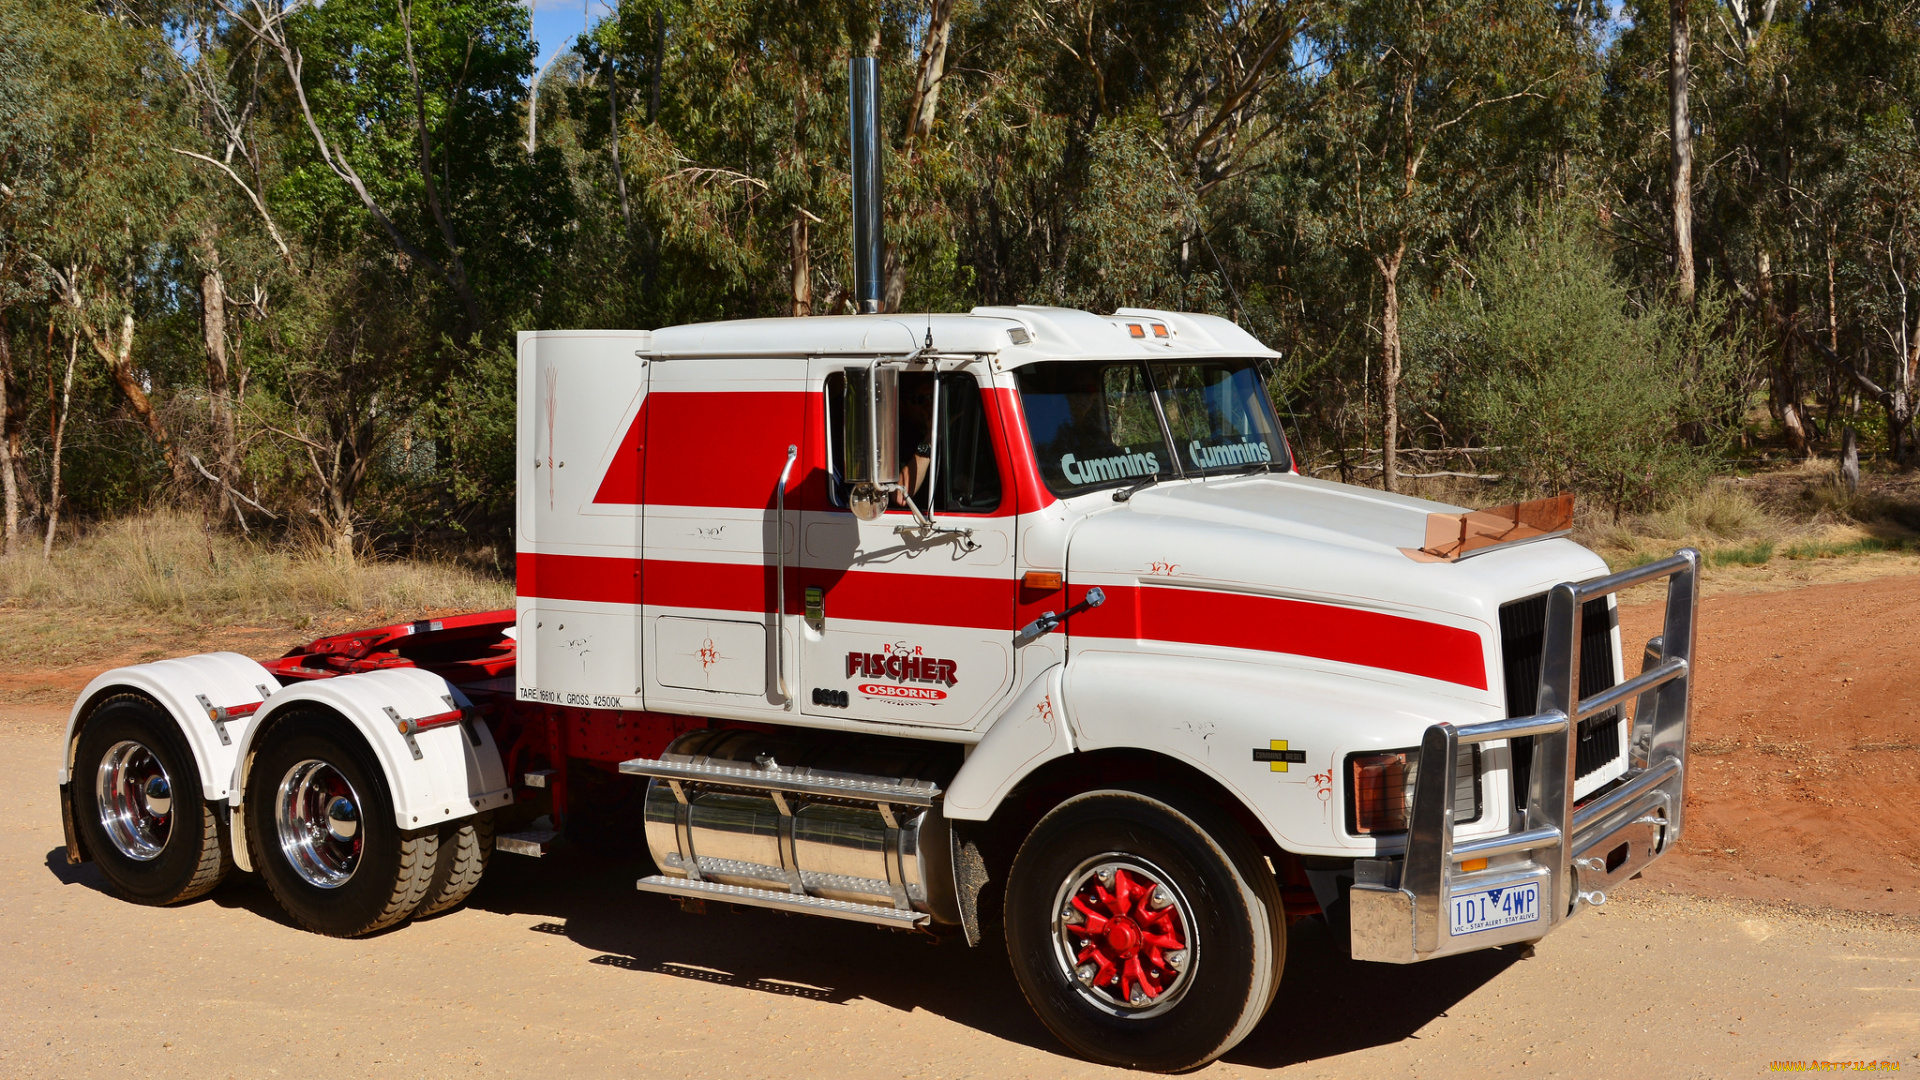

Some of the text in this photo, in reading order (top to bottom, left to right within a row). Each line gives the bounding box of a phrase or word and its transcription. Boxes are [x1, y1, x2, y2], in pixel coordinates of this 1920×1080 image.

[1061, 447, 1160, 485] Cummins
[1189, 437, 1272, 468] Cummins
[884, 643, 892, 654] R
[915, 645, 923, 656] R
[846, 651, 959, 688] FISCHER
[865, 685, 939, 699] OSBORNE
[1456, 889, 1535, 926] 1DI 4WP
[1470, 922, 1484, 930] STAY
[1485, 919, 1502, 927] ALERT
[1505, 916, 1518, 924] STAY
[1519, 913, 1535, 921] ALIVE
